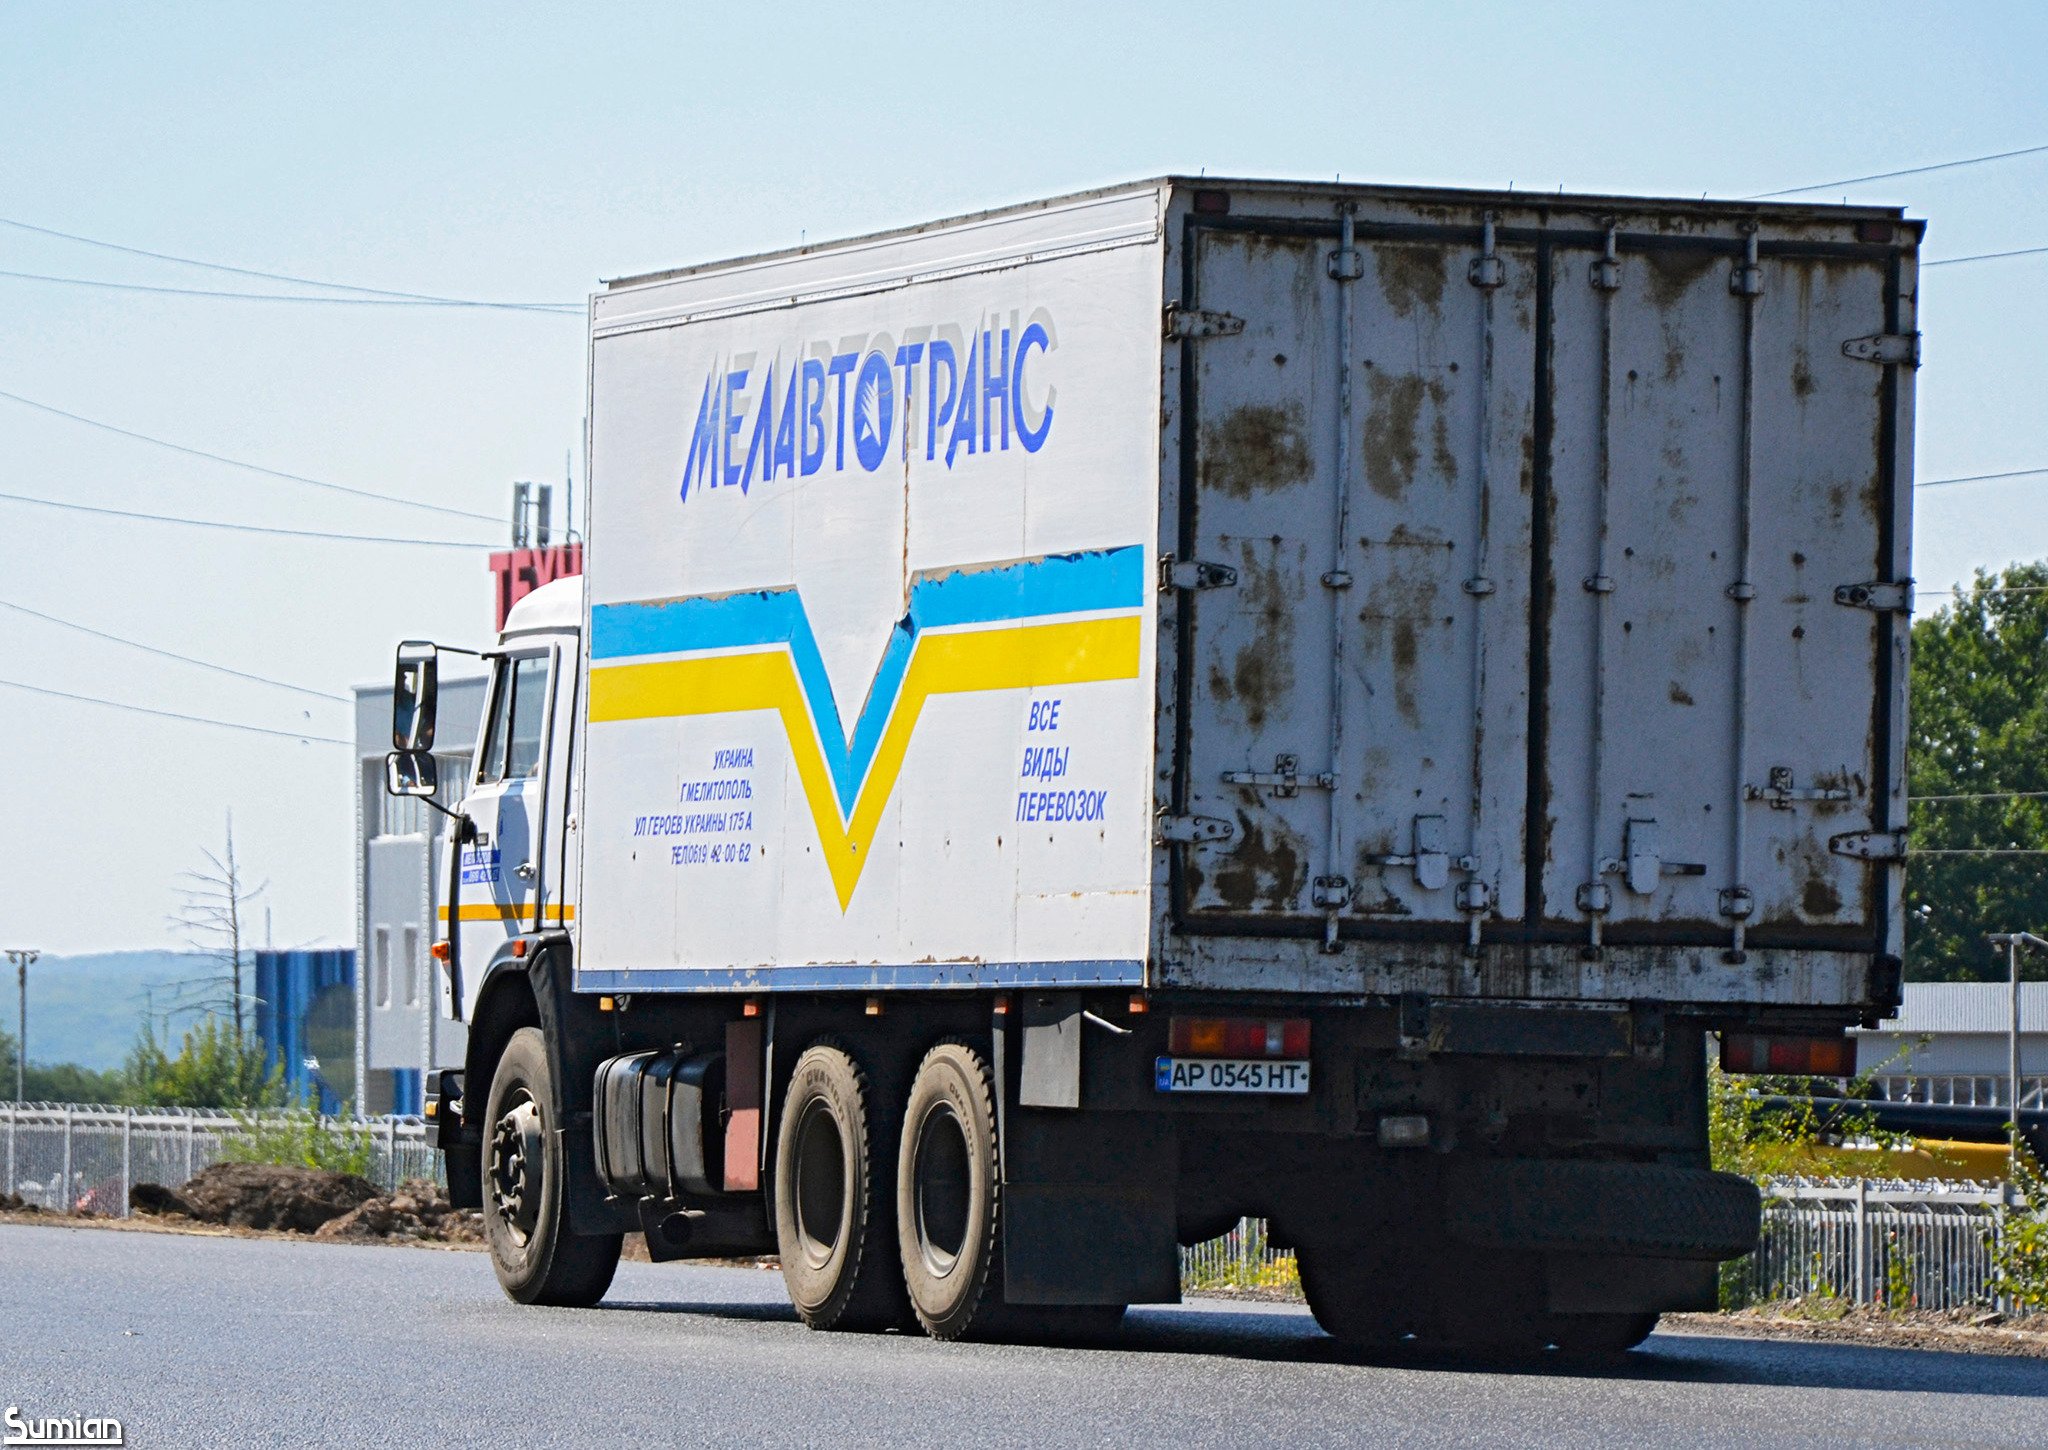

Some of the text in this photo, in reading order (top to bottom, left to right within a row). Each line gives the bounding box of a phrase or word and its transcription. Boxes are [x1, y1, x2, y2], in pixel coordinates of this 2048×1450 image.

[680, 322, 1054, 504] МЕЛАВТОТРАНС
[1028, 699, 1062, 731] ВСЕ
[1021, 746, 1070, 783] ВИДЫ
[1016, 789, 1108, 822] ПЕРЕВОЗОК
[647, 814, 683, 835] ГЕРОЕВ
[1172, 1063, 1205, 1087] AP
[1211, 1063, 1262, 1088] 0545
[1268, 1064, 1301, 1089] HT
